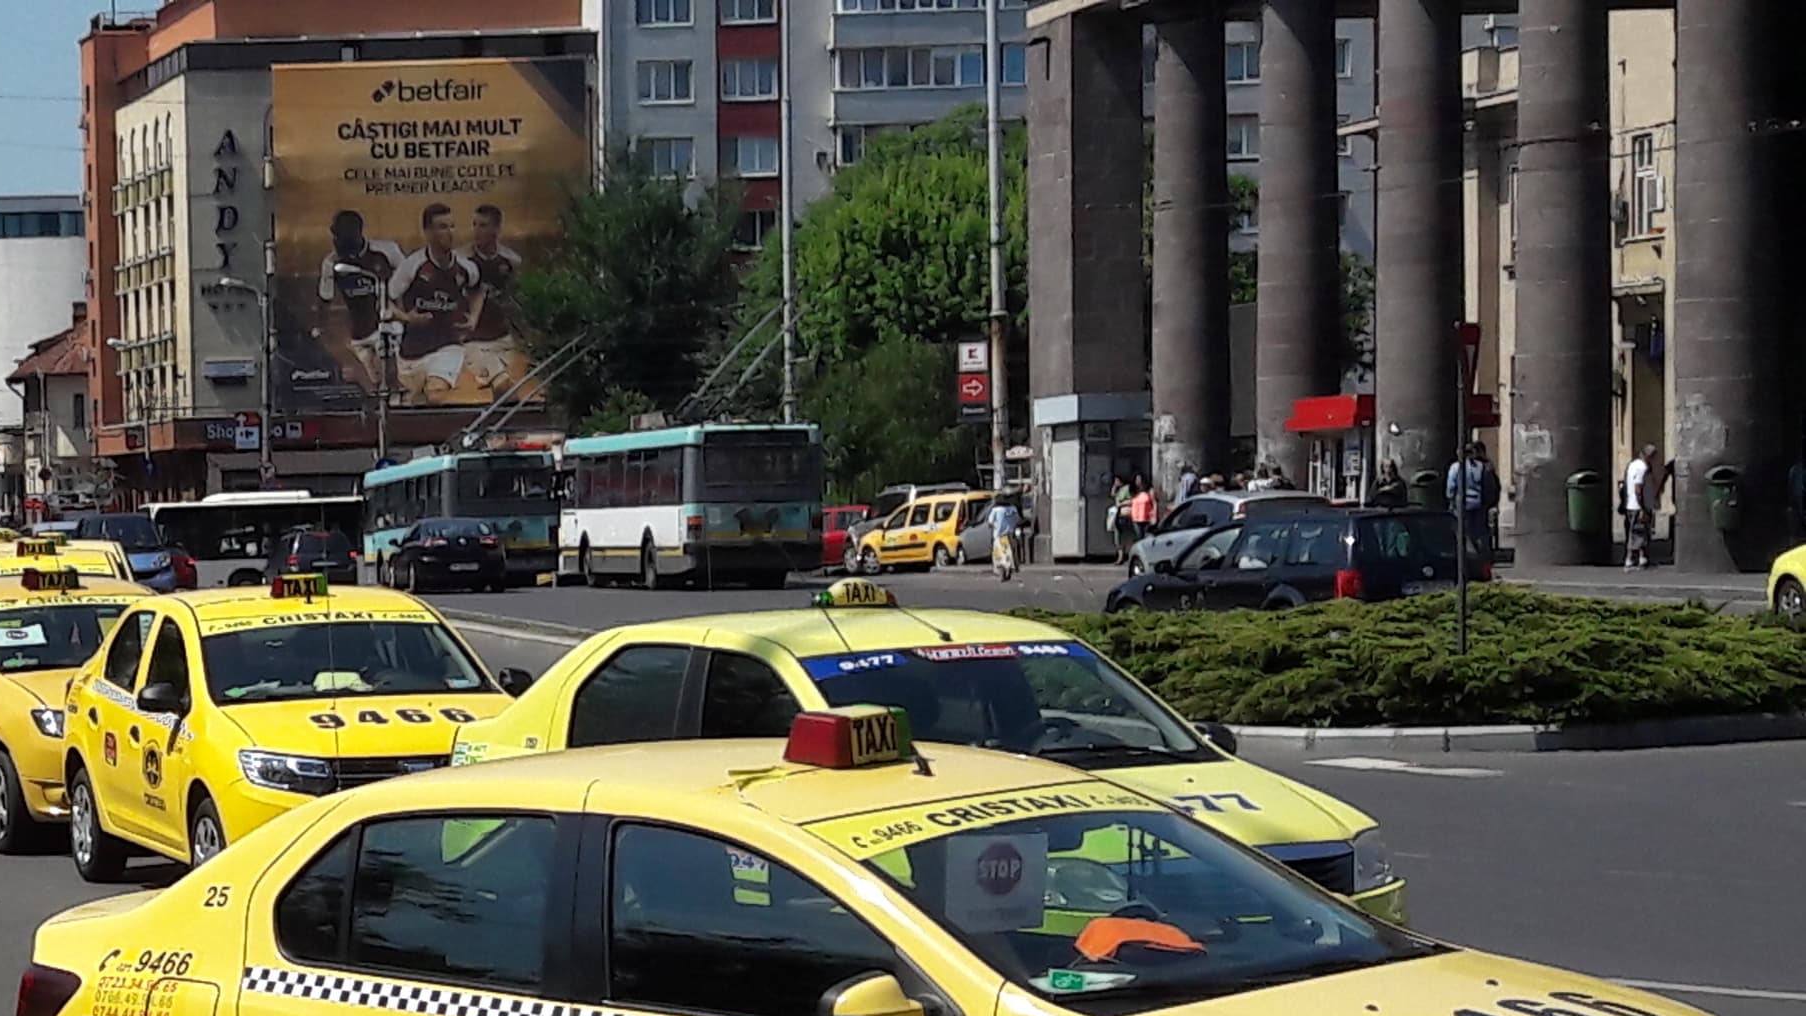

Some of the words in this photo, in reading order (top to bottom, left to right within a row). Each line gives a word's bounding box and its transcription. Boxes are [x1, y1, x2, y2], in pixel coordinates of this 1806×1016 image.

[398, 78, 485, 102] betfair
[422, 120, 461, 138] MAI
[466, 118, 523, 137] MULT
[371, 142, 399, 159] CU
[404, 140, 491, 159] BETFAIR
[384, 167, 411, 180] MAI
[285, 578, 318, 596] TAXI
[843, 582, 876, 603] TAXI
[262, 612, 375, 625] CRISTAXI
[309, 708, 477, 729] 9466
[853, 716, 898, 758] TAXI
[926, 795, 1092, 827] CRISTAXI
[979, 860, 1022, 880] STOP
[203, 885, 232, 908] 25
[134, 950, 193, 976] 9466
